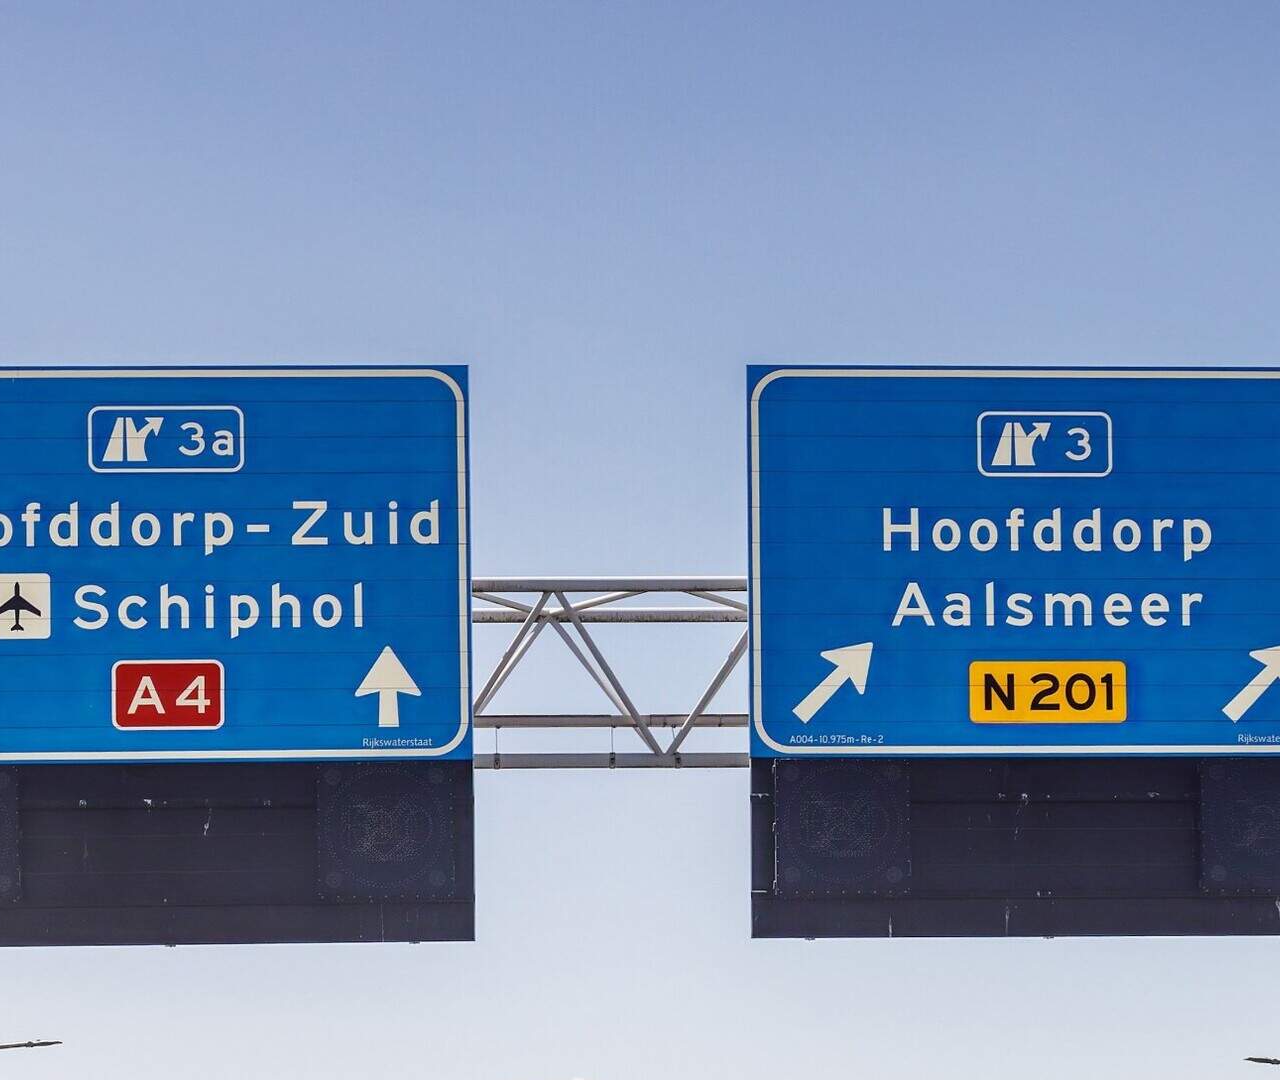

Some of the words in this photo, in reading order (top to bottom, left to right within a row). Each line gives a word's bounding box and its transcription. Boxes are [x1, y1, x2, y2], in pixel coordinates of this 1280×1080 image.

[178, 422, 234, 456] 3a
[1065, 427, 1092, 461] 3
[882, 507, 1212, 562] Hoofddorp
[73, 582, 364, 639] Schiphol
[891, 581, 1203, 627] Aalsmeer
[362, 737, 433, 749] Rijkswaterstaat
